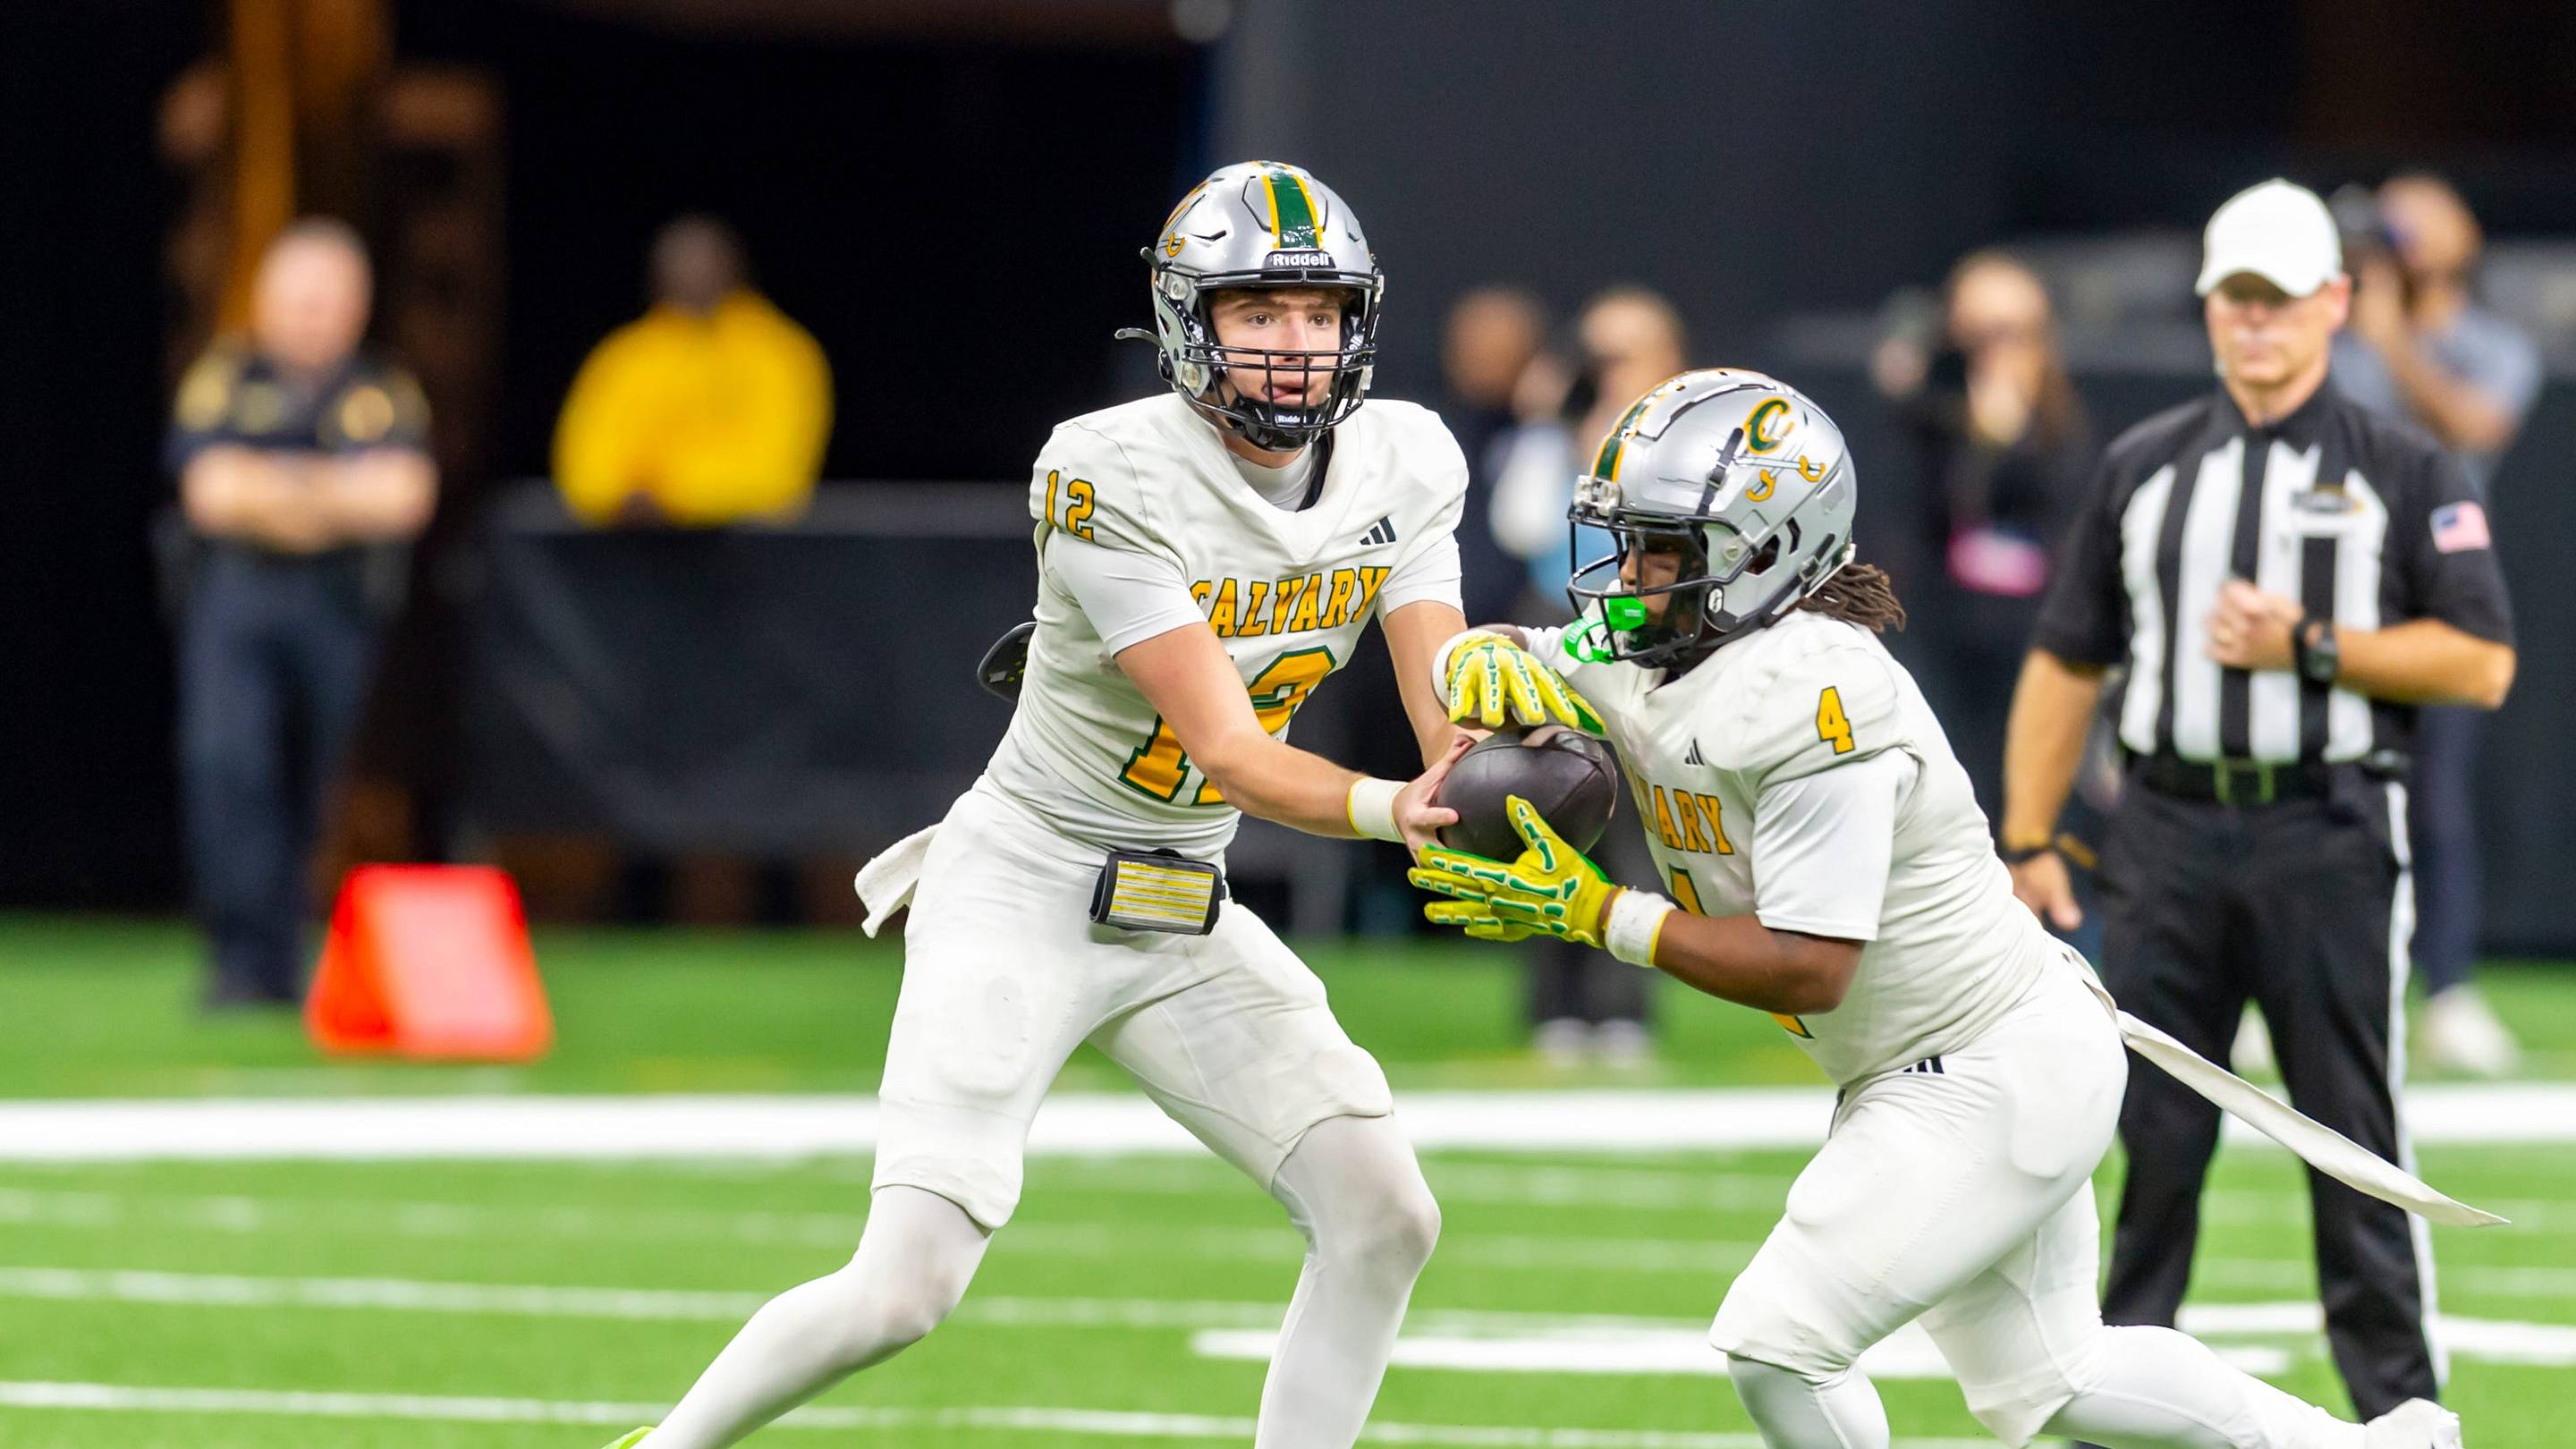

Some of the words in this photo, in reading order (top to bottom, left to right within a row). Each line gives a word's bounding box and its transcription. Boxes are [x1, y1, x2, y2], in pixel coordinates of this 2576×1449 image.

[1272, 253, 1330, 267] Riddell
[1742, 397, 1794, 455] C
[1045, 469, 1096, 543] 12
[1816, 685, 1856, 756] 4
